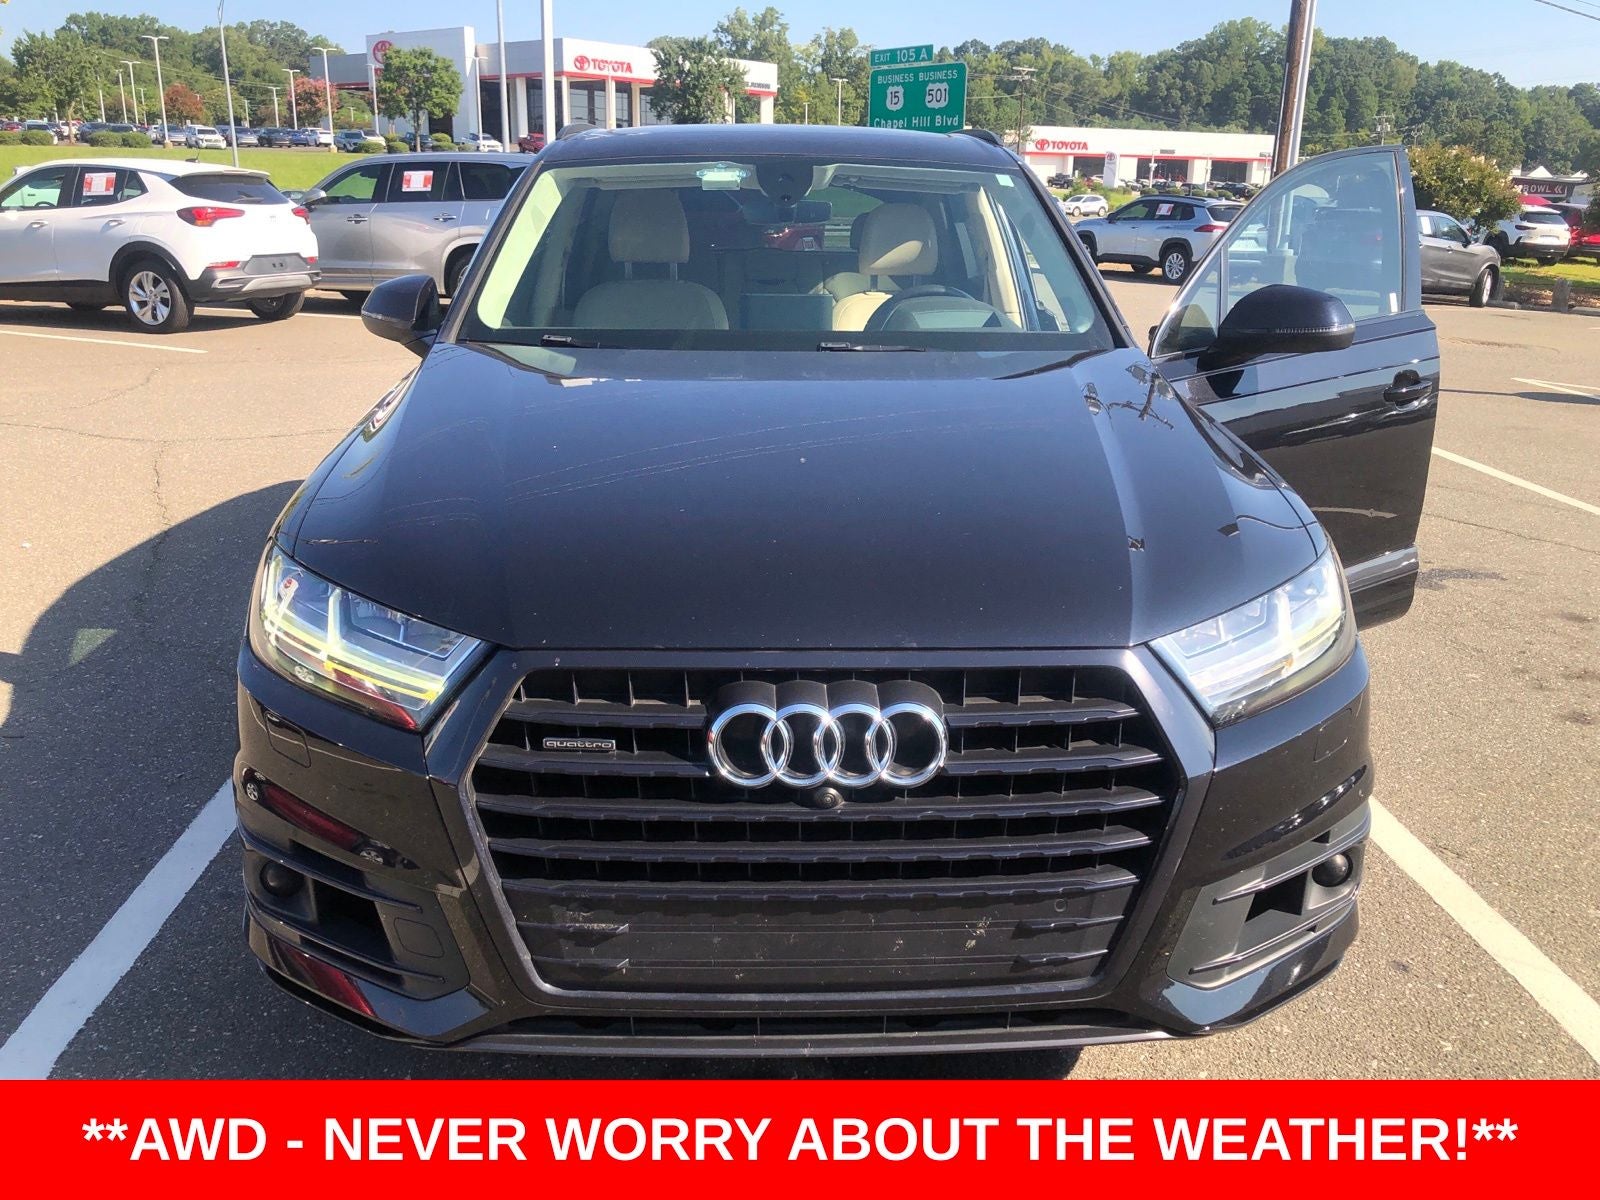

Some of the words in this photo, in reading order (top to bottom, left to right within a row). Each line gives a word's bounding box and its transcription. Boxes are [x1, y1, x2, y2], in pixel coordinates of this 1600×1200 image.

[874, 53, 891, 63] EXIT
[896, 49, 916, 62] 105
[919, 48, 928, 60] A
[591, 58, 633, 74] TOYOTA
[877, 73, 915, 84] BUSINESS
[918, 70, 958, 81] BUSINESS
[890, 91, 900, 105] 15
[927, 88, 947, 103] 501
[873, 117, 907, 129] Chapel
[911, 116, 931, 127] Hill
[935, 115, 959, 126] Blvd
[1051, 140, 1089, 151] TOYOTA
[1523, 184, 1552, 193] BOWL
[546, 740, 612, 749] quattro
